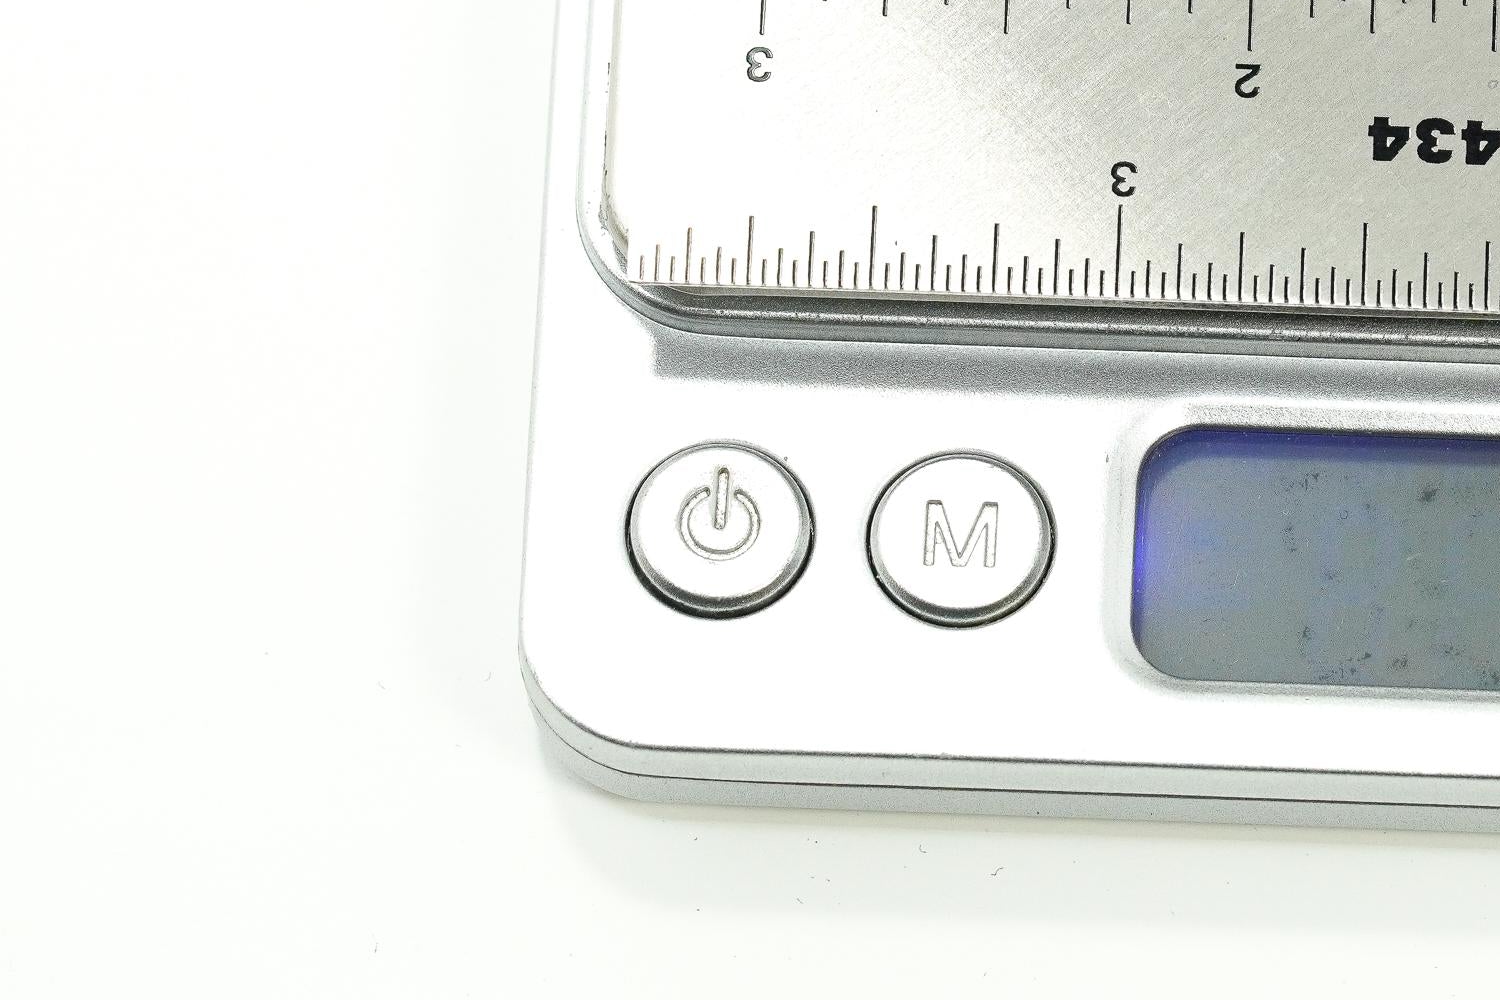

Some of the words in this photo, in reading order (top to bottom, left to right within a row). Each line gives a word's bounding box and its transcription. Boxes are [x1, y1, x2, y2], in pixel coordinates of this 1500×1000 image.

[744, 45, 775, 84] 3
[1233, 62, 1263, 100] 2
[1109, 159, 1139, 199] 3
[921, 498, 1000, 569] M
